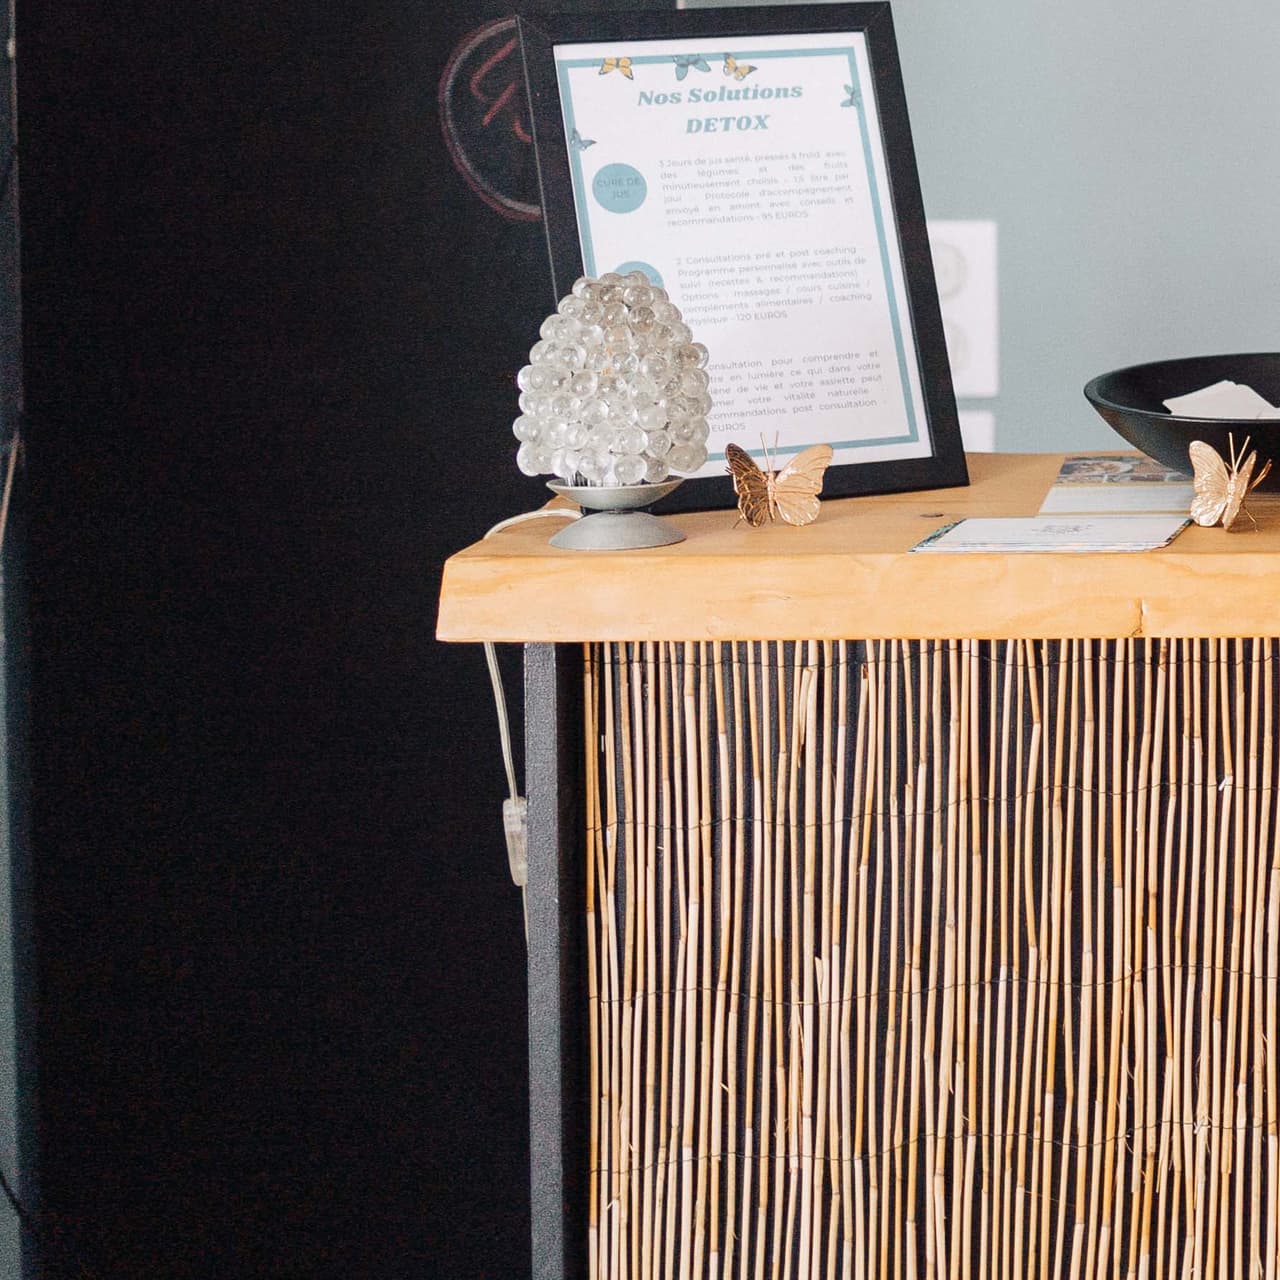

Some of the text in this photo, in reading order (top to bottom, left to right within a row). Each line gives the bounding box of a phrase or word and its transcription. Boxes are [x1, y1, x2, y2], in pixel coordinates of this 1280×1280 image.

[638, 83, 803, 106] Nos Solutions
[685, 114, 771, 134] DETOX
[694, 157, 706, 166] de
[596, 175, 642, 187] CURE DE
[660, 172, 677, 181] des
[754, 310, 788, 320] EUROS
[708, 360, 762, 372] onsultation
[730, 373, 742, 381] en
[808, 366, 823, 376] qui
[829, 365, 851, 374] dans
[737, 384, 749, 393] de
[792, 404, 813, 414] post
[819, 398, 878, 411] consultation
[712, 422, 746, 433] EUROS
